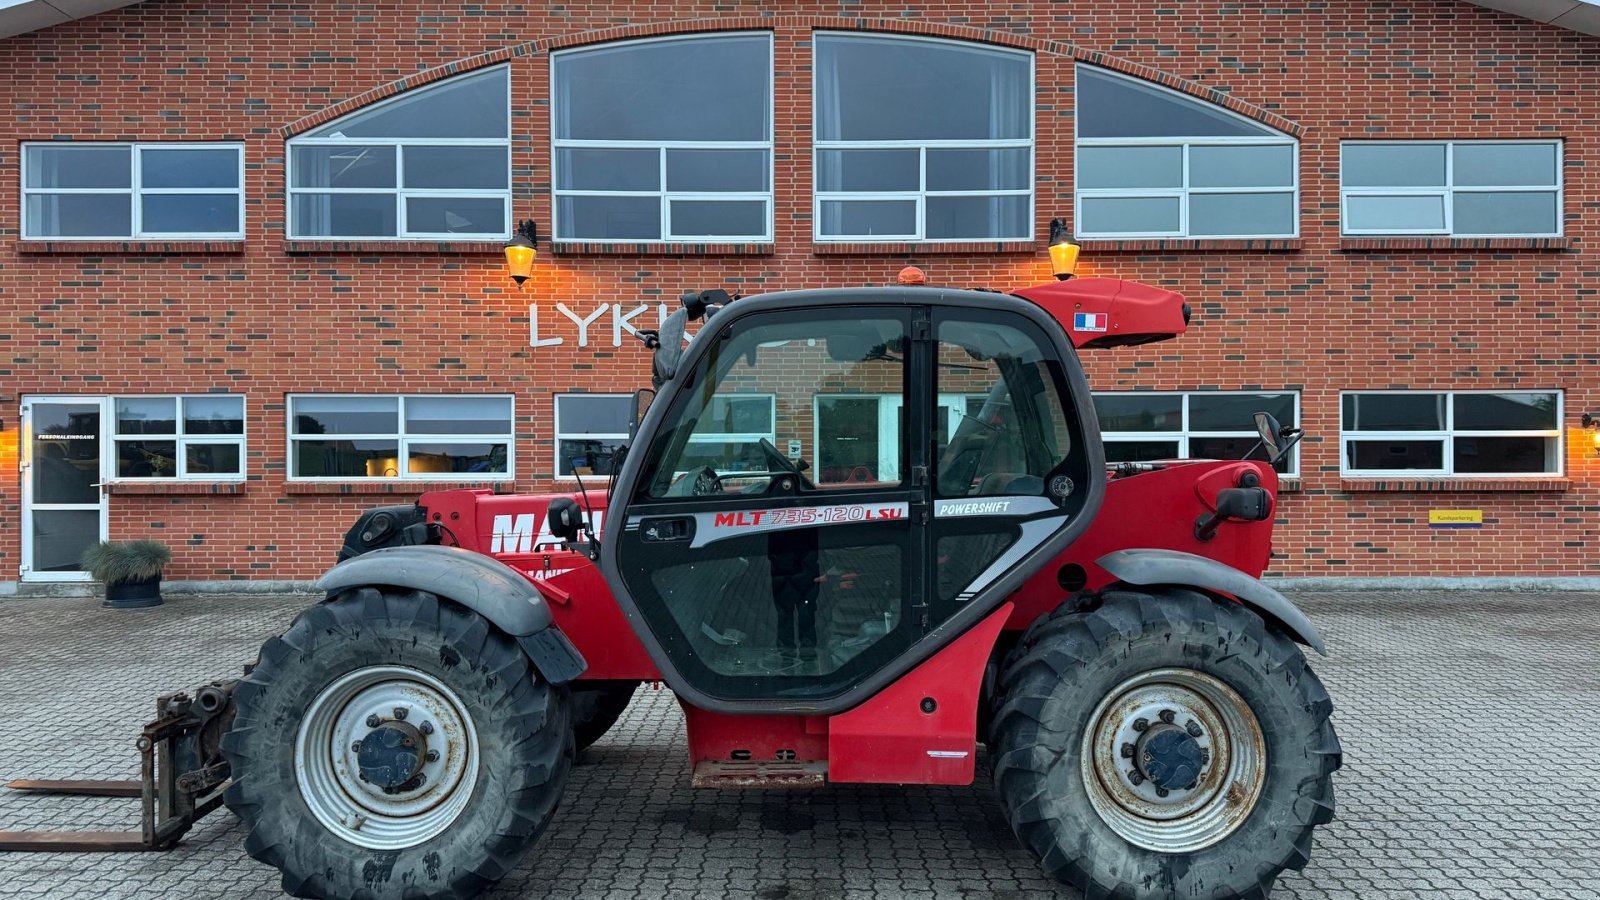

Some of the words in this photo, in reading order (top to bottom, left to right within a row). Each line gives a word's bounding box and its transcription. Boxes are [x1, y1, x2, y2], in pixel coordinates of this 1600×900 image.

[714, 511, 767, 527] MLT
[771, 506, 864, 525] 735-120
[865, 508, 902, 520] LSU
[940, 501, 1010, 515] POWERSHIFT
